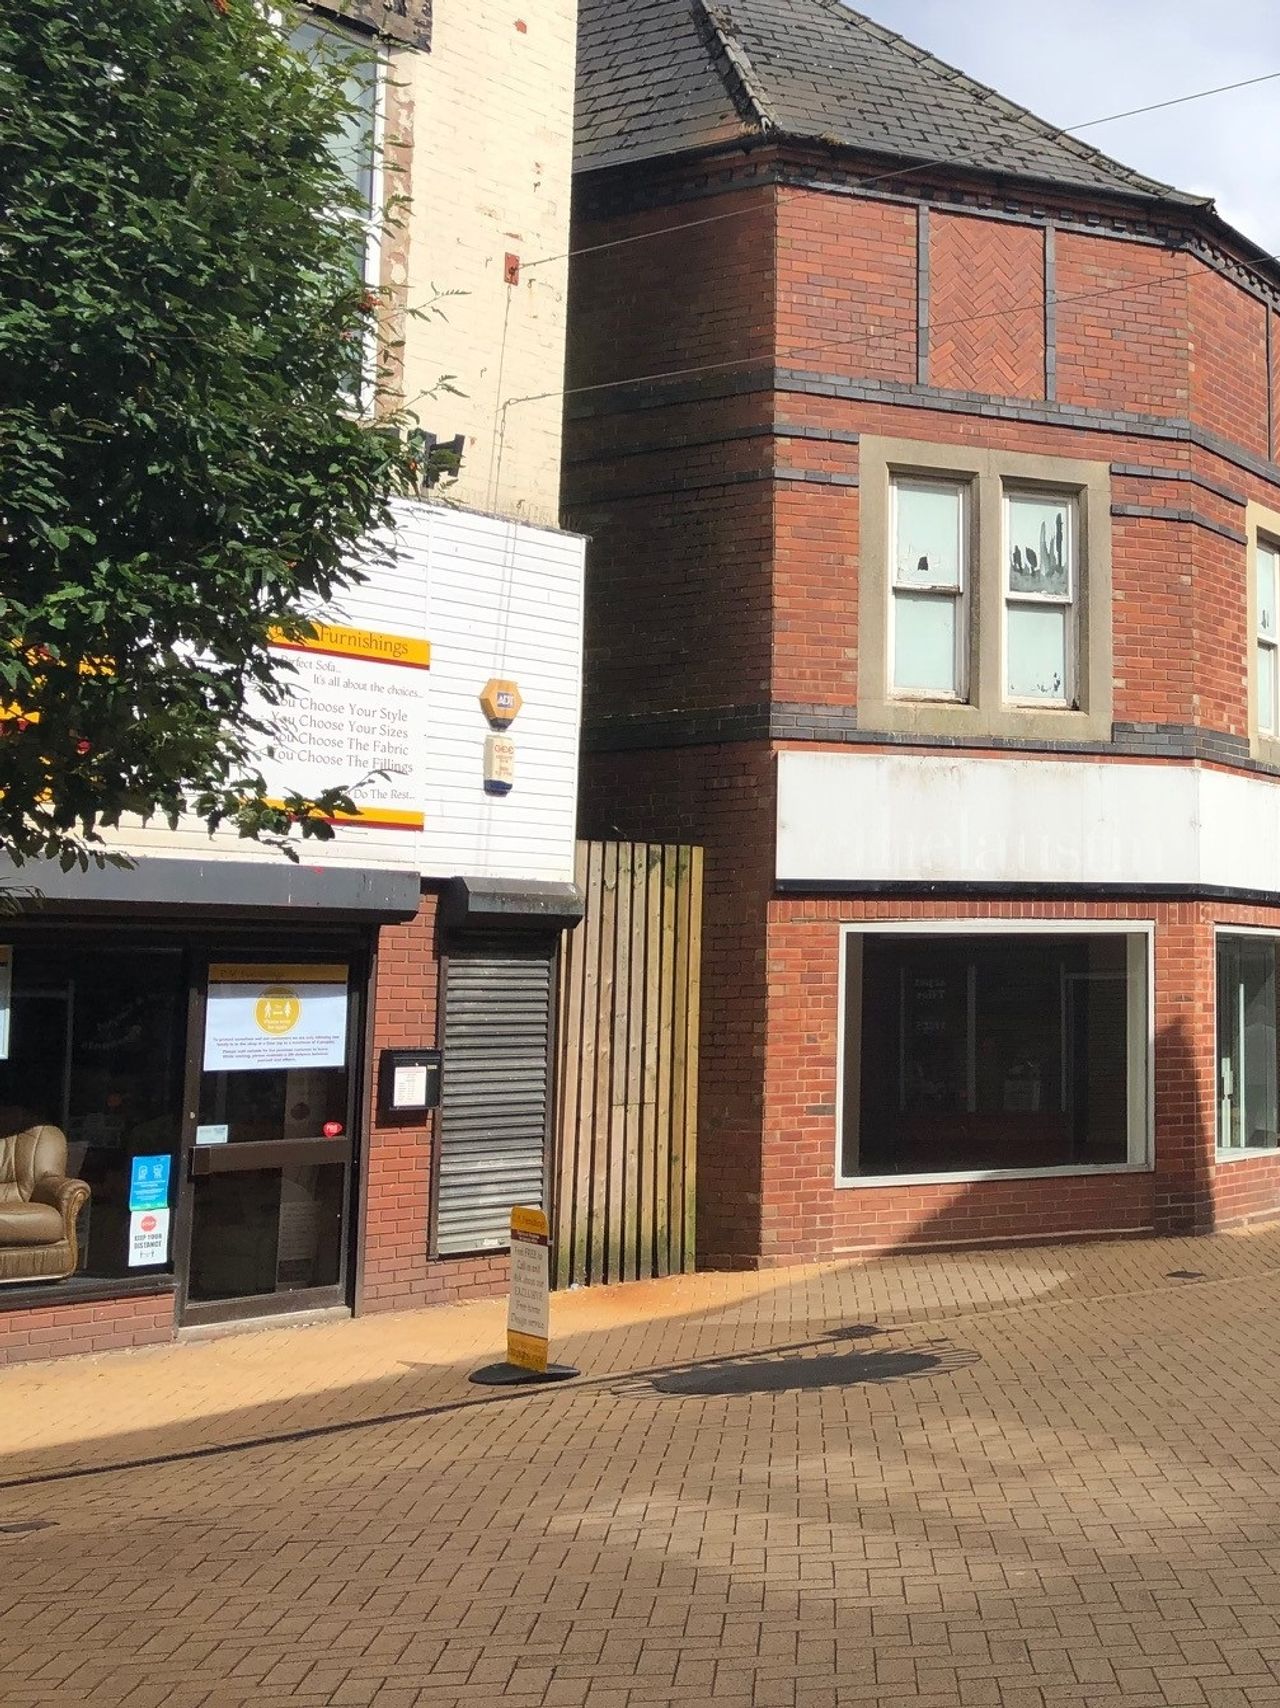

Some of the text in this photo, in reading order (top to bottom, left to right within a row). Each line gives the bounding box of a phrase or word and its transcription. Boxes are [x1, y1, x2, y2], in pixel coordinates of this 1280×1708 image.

[320, 625, 408, 657] Furnishings
[328, 676, 340, 688] all
[342, 678, 368, 691] about
[370, 681, 386, 692] the
[300, 697, 345, 714] Choose
[349, 703, 377, 717] Your
[379, 707, 408, 723] Style
[299, 714, 344, 731] Choose
[349, 720, 377, 735] Your
[379, 725, 408, 739] Sizes
[298, 731, 344, 748] Choose
[347, 738, 369, 751] The
[373, 741, 409, 756] Fabric
[298, 750, 343, 766] Choose
[346, 754, 369, 768] The
[372, 758, 413, 775] Fillings
[354, 789, 368, 799] Do
[370, 788, 388, 799] The
